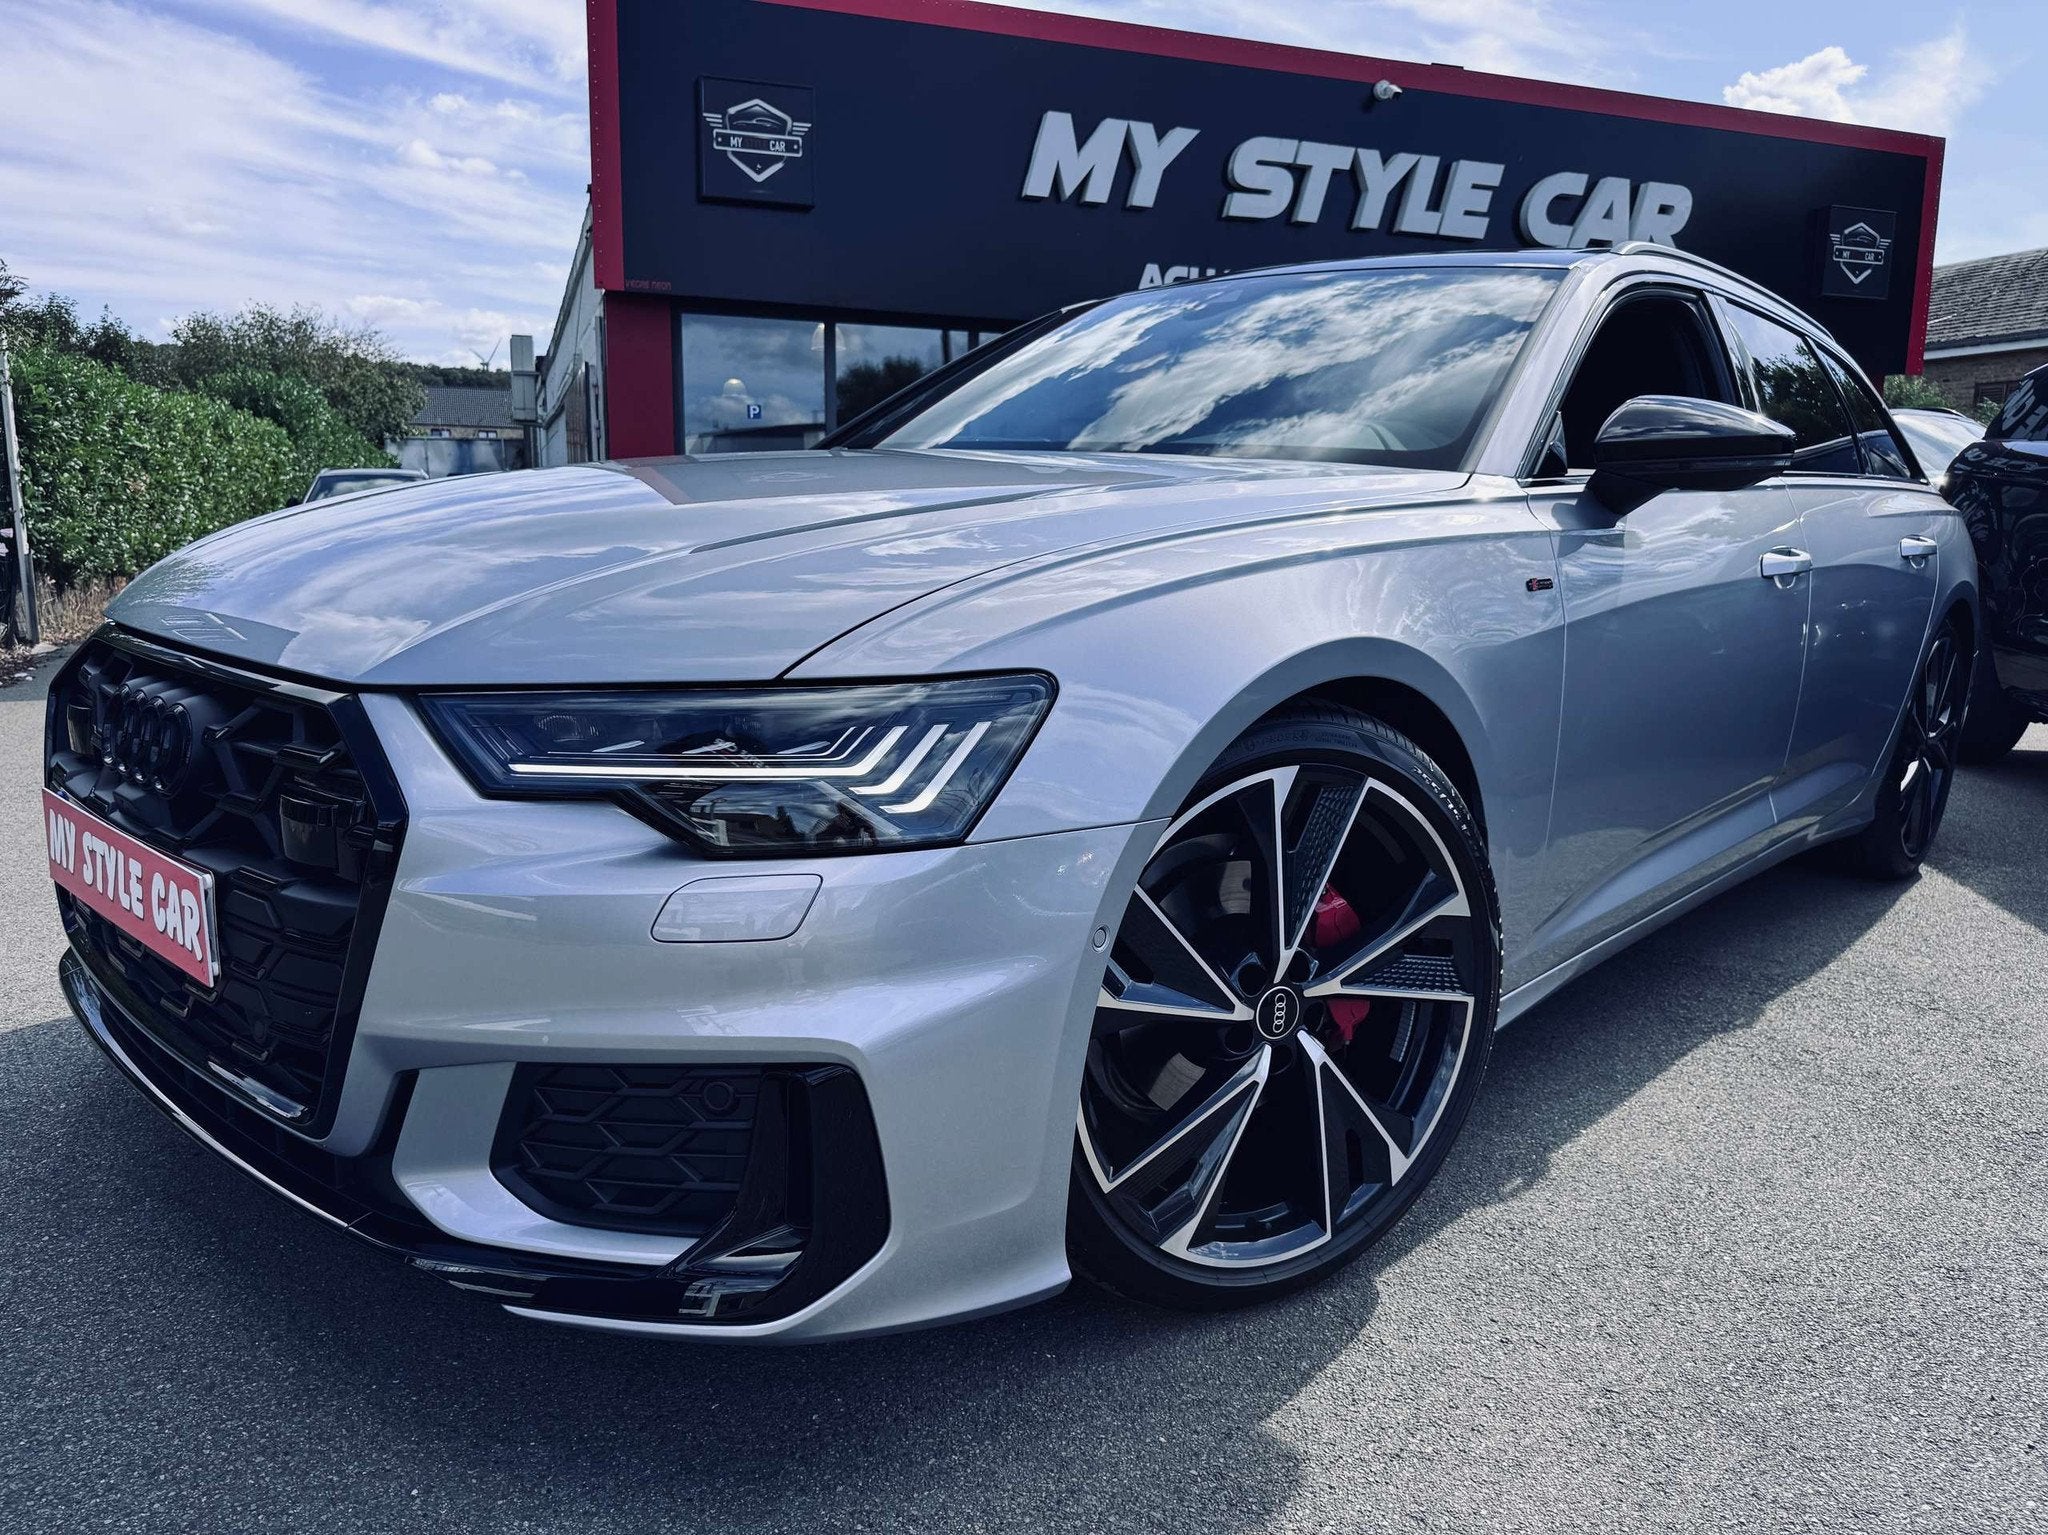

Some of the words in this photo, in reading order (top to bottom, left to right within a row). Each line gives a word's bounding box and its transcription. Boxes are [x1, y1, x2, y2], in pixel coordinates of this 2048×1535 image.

[730, 136, 743, 148] MY
[769, 140, 786, 152] CAR
[1022, 110, 1200, 208] MY
[1222, 135, 1504, 239] STYLE
[1520, 171, 1693, 248] CAR
[1864, 252, 1875, 261] CAR
[750, 405, 760, 419] P
[50, 808, 76, 874] MY
[82, 831, 144, 919] STYLE
[151, 872, 203, 962] CAR
